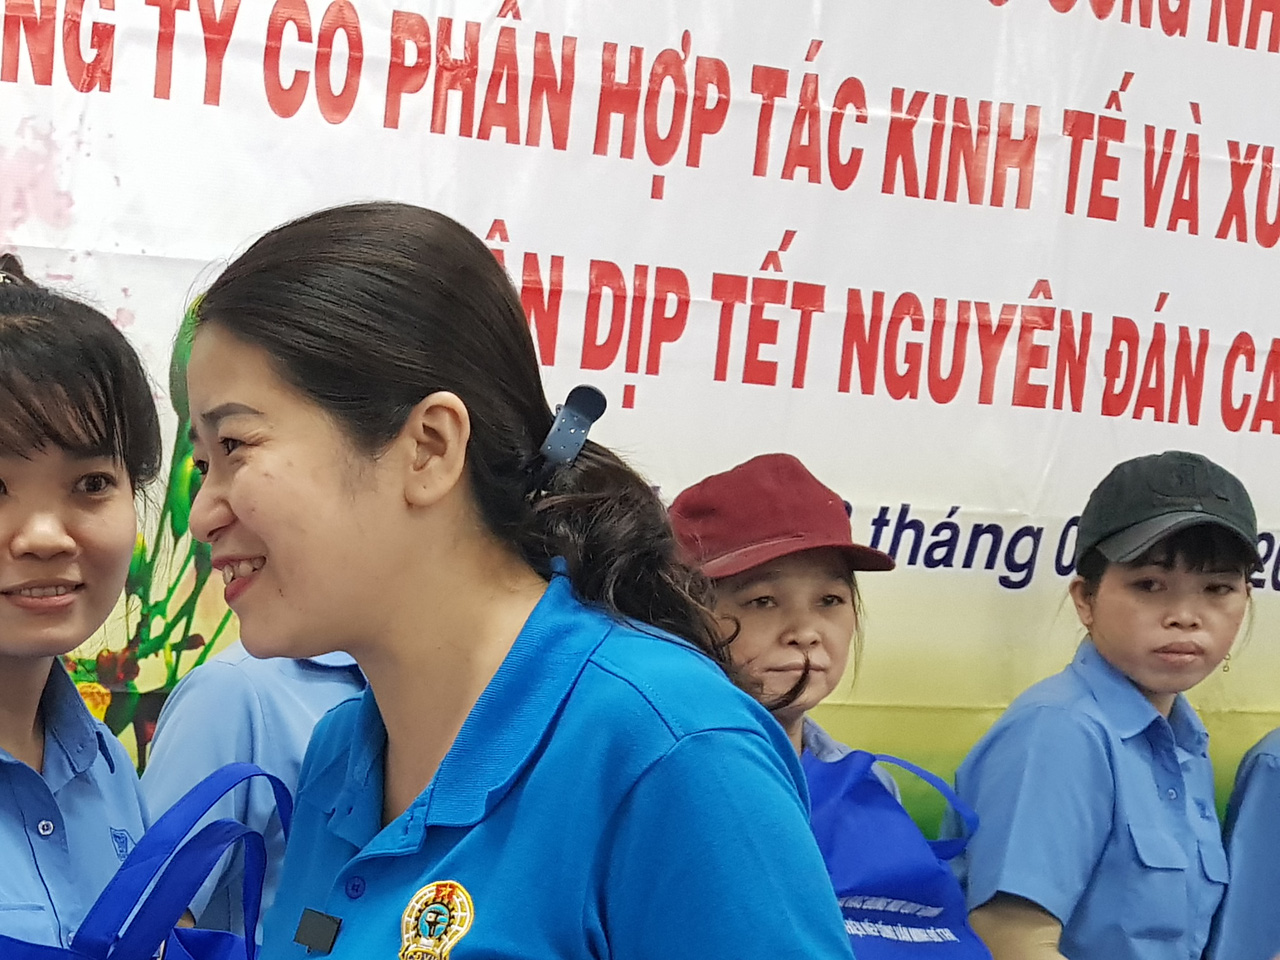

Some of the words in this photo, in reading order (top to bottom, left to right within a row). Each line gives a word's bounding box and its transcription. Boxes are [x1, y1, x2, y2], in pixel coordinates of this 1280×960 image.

[145, 0, 241, 106] TY
[593, 30, 731, 200] HỢP
[751, 40, 867, 191] TÁC
[881, 87, 1040, 210] KINH
[1063, 71, 1135, 221] TẾ
[1144, 101, 1201, 237] VÀ
[579, 259, 690, 410] DỊP
[710, 230, 826, 389] TẾT
[837, 279, 1092, 413] NGUYÊN
[1100, 291, 1210, 426] ĐÁN
[870, 503, 1045, 590] tháng
